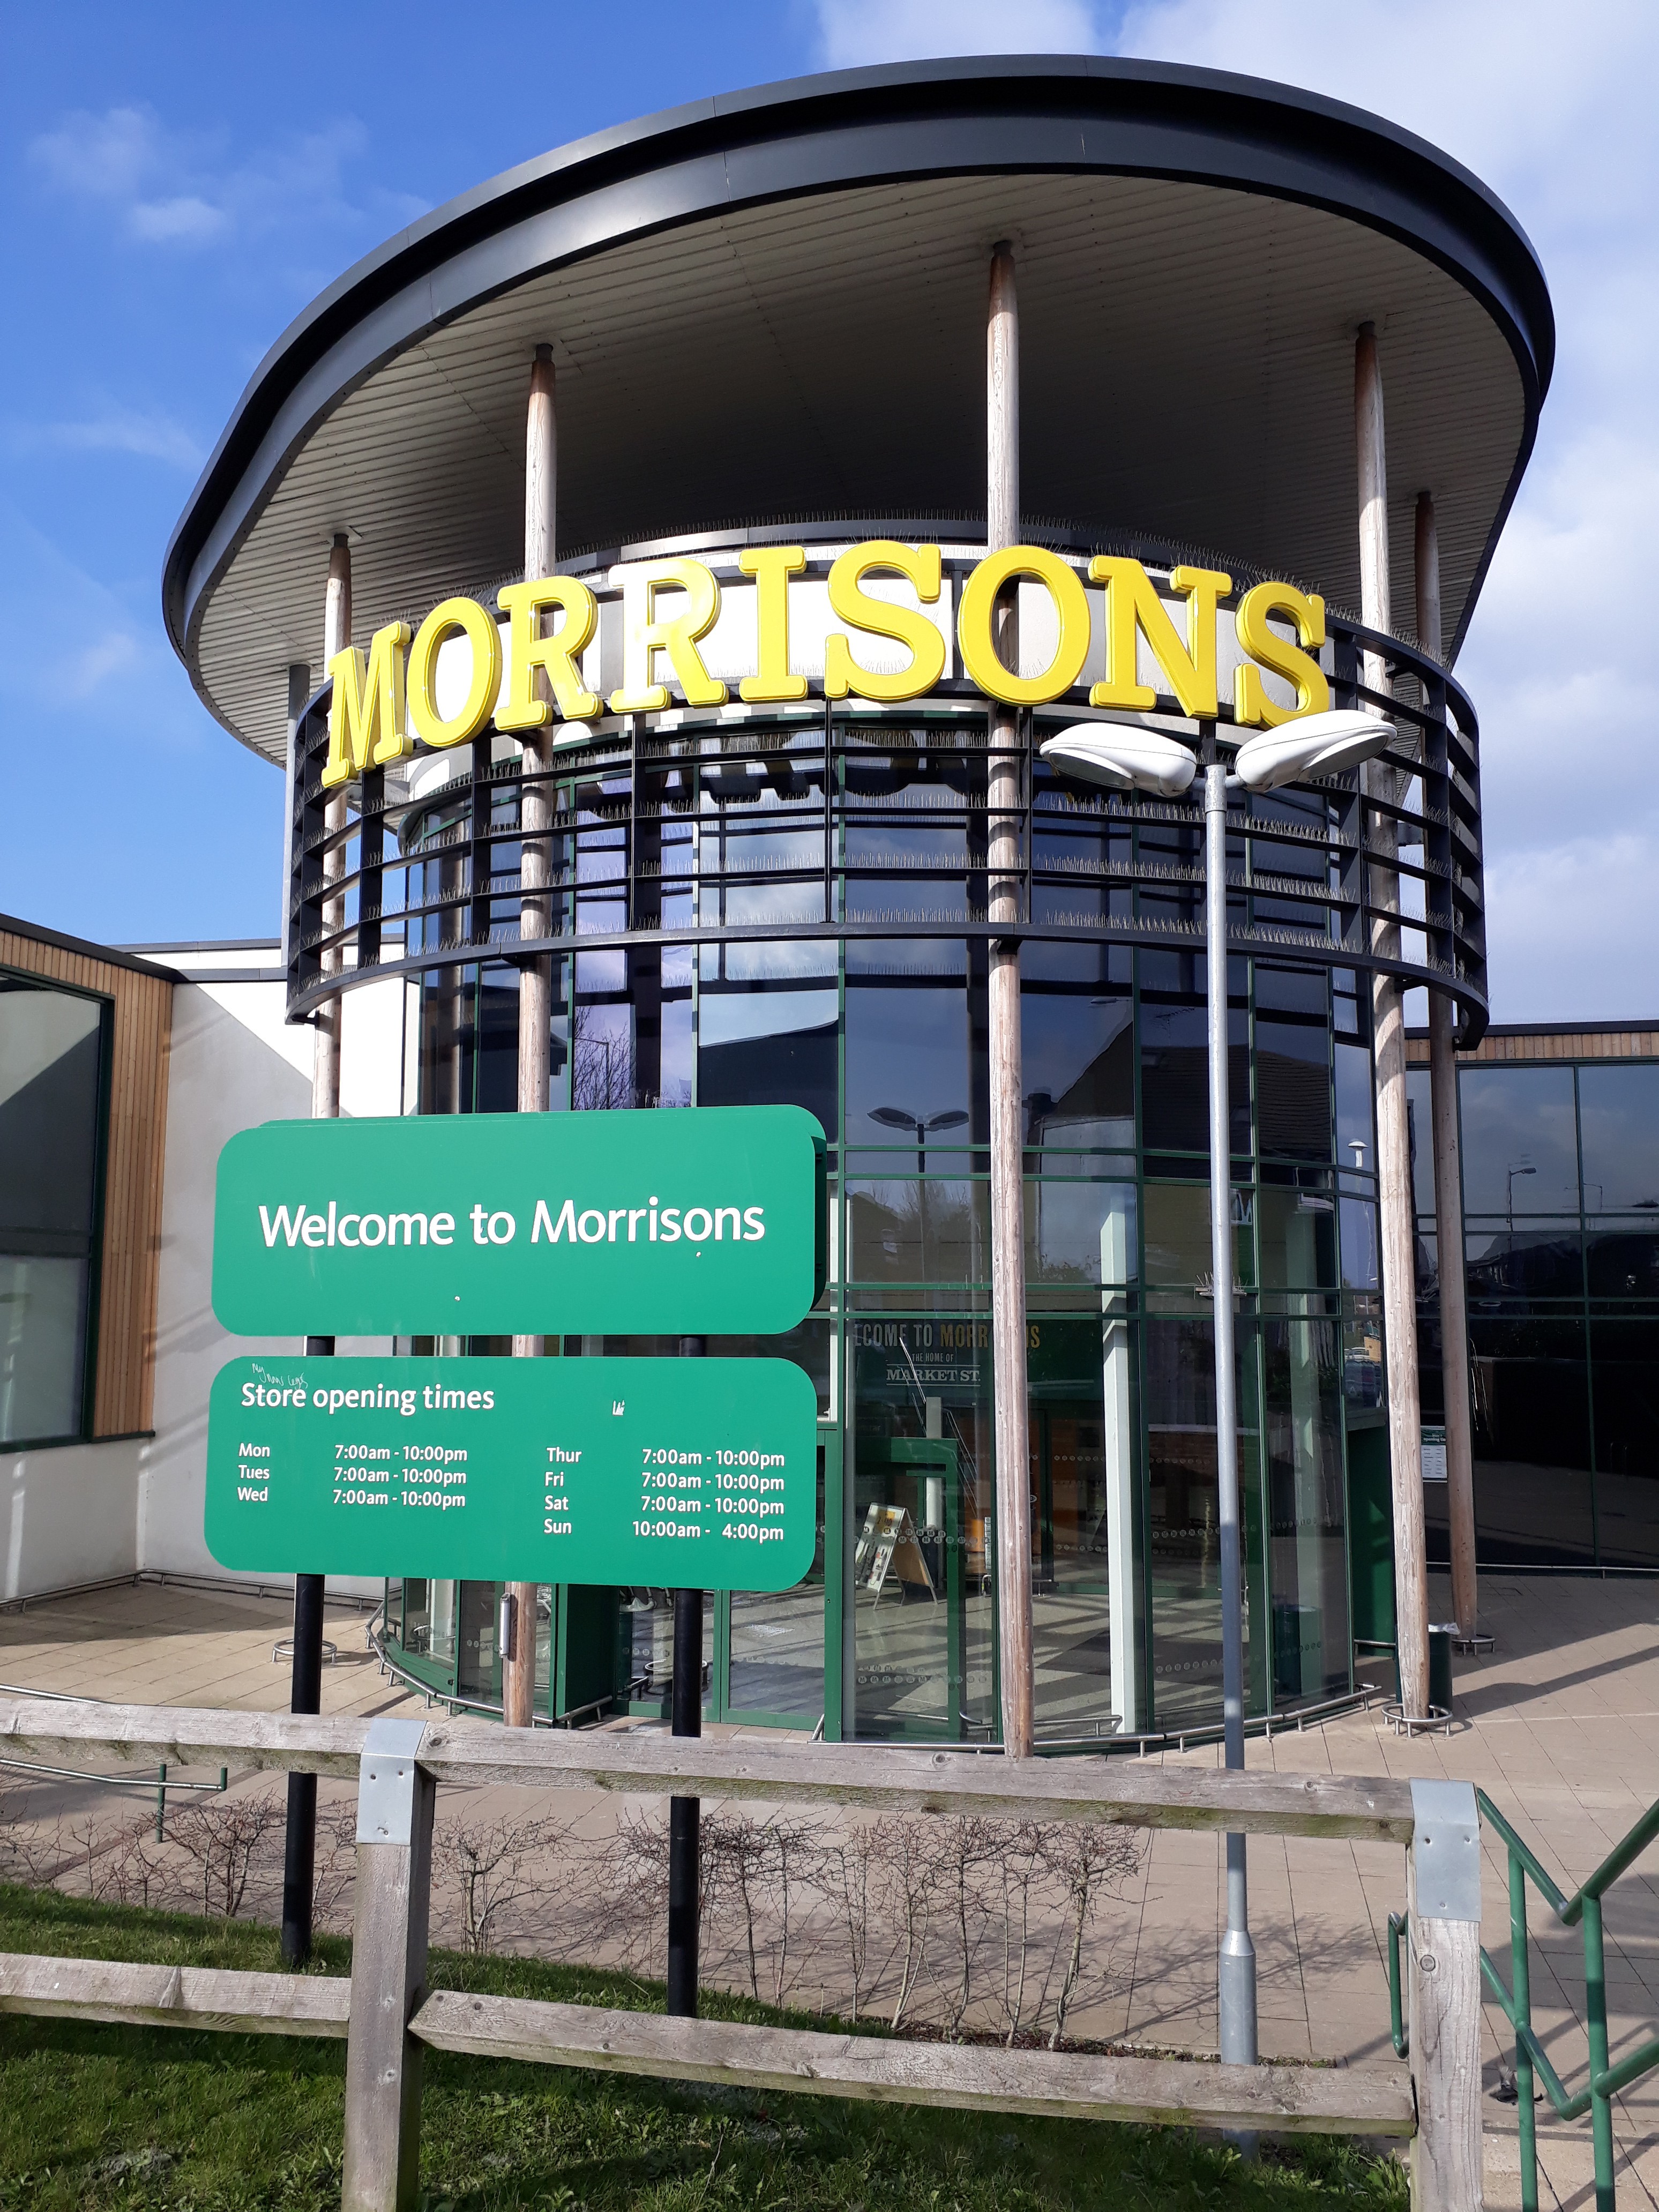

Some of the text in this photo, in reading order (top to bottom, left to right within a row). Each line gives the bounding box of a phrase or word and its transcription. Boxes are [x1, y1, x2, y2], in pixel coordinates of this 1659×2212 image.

[320, 540, 1329, 789] MORRISONS
[259, 1196, 765, 1247] Welcome to Morrisons
[913, 1324, 932, 1347] TO
[911, 1352, 954, 1362] THE HOME OF
[886, 1369, 981, 1381] MARKET ST.
[241, 1382, 495, 1416] Store opening times
[238, 1443, 270, 1457] Mon
[335, 1445, 390, 1459] 7:00am
[403, 1446, 467, 1464] 10:00pm
[547, 1446, 582, 1462] Thur
[642, 1448, 701, 1464] 7:00am
[715, 1450, 784, 1469] 10:00pm
[238, 1464, 270, 1479] Tues
[334, 1467, 389, 1482] 7:00am
[402, 1468, 466, 1487] 10:00pm
[545, 1471, 564, 1486] Fri
[642, 1472, 701, 1488] 7:00am
[715, 1474, 784, 1493] 10:00pm
[237, 1486, 268, 1501] Wed
[333, 1489, 388, 1505] 7:00am
[401, 1491, 465, 1511] 10:00pm
[544, 1495, 569, 1510] Sat
[641, 1496, 701, 1512] 7:00am
[715, 1497, 784, 1518] 10:00pm
[544, 1518, 572, 1534] Sun
[632, 1521, 700, 1537] 10:00am
[722, 1523, 783, 1544] 4:00pm
